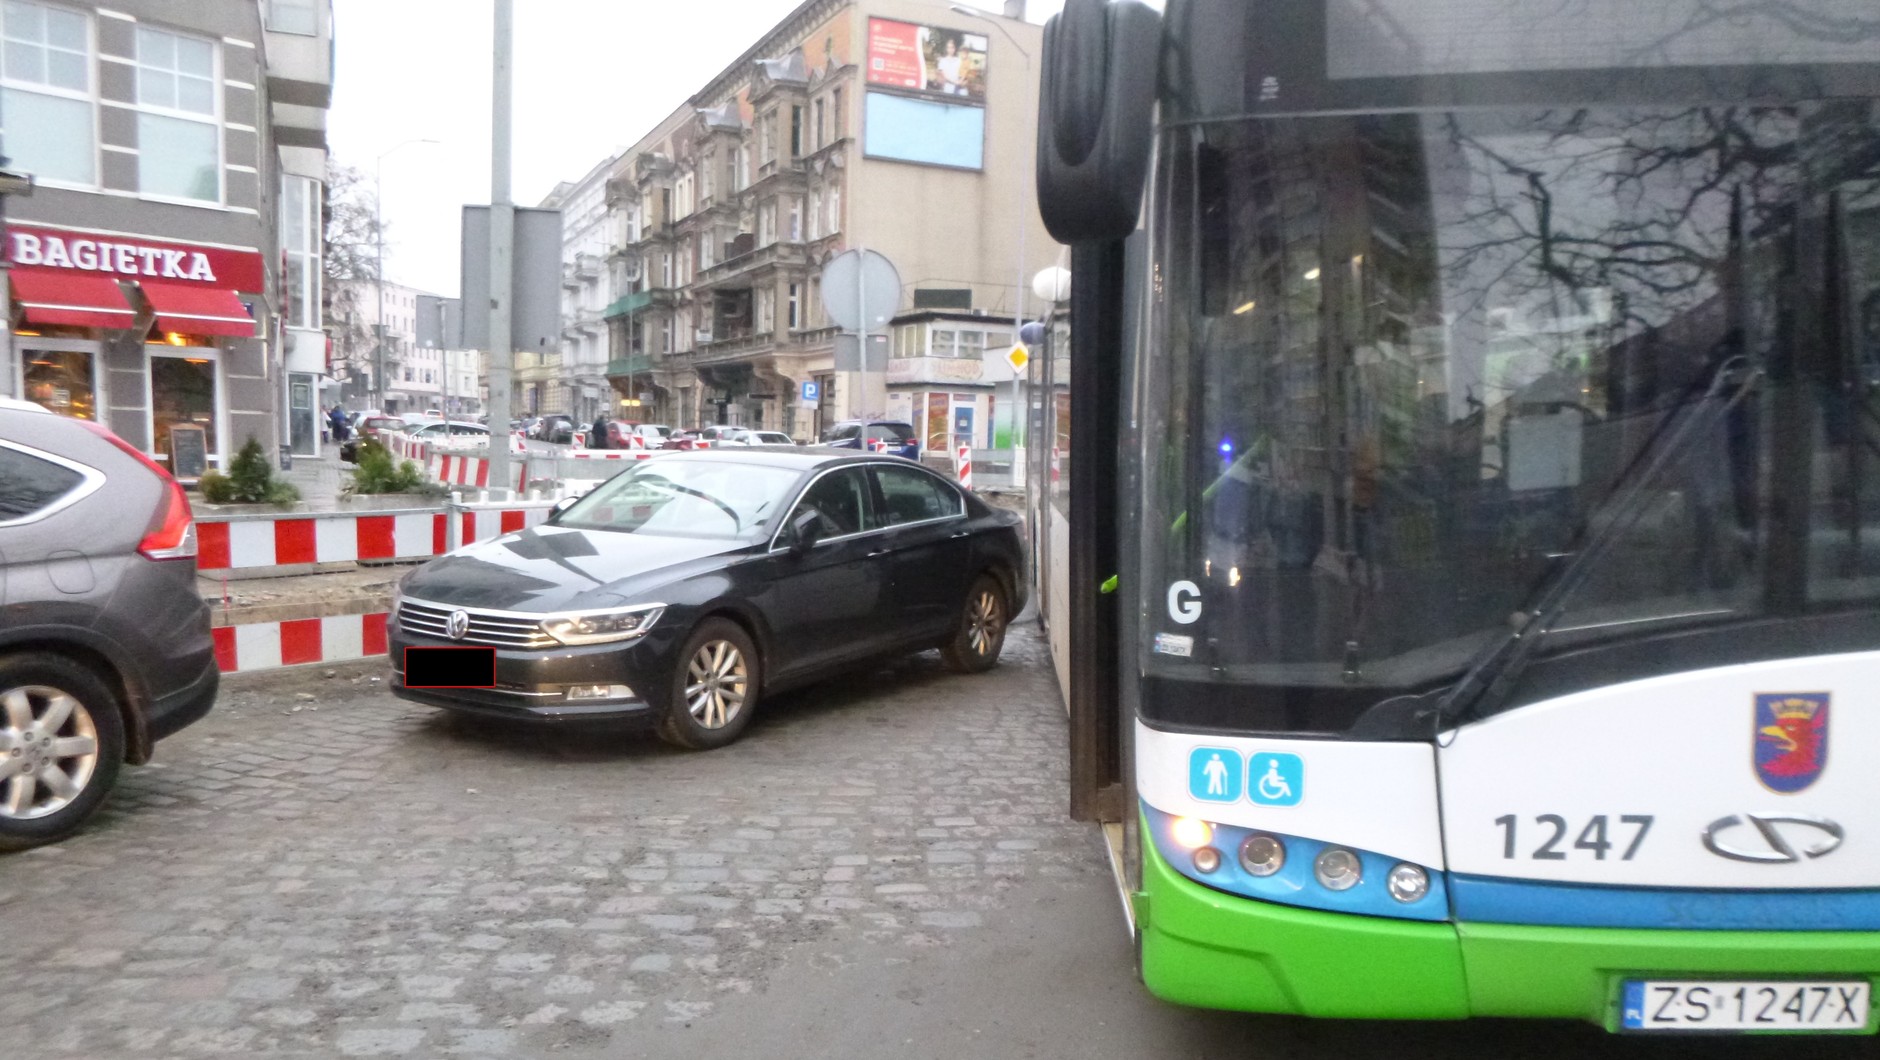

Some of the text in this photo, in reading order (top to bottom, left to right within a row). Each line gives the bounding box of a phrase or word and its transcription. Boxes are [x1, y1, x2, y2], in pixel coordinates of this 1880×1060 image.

[11, 233, 216, 282] BAGIETKA
[805, 383, 816, 398] P
[1167, 580, 1203, 624] G
[1494, 813, 1655, 861] 1247
[1652, 987, 1860, 1023] ZS 1247X
